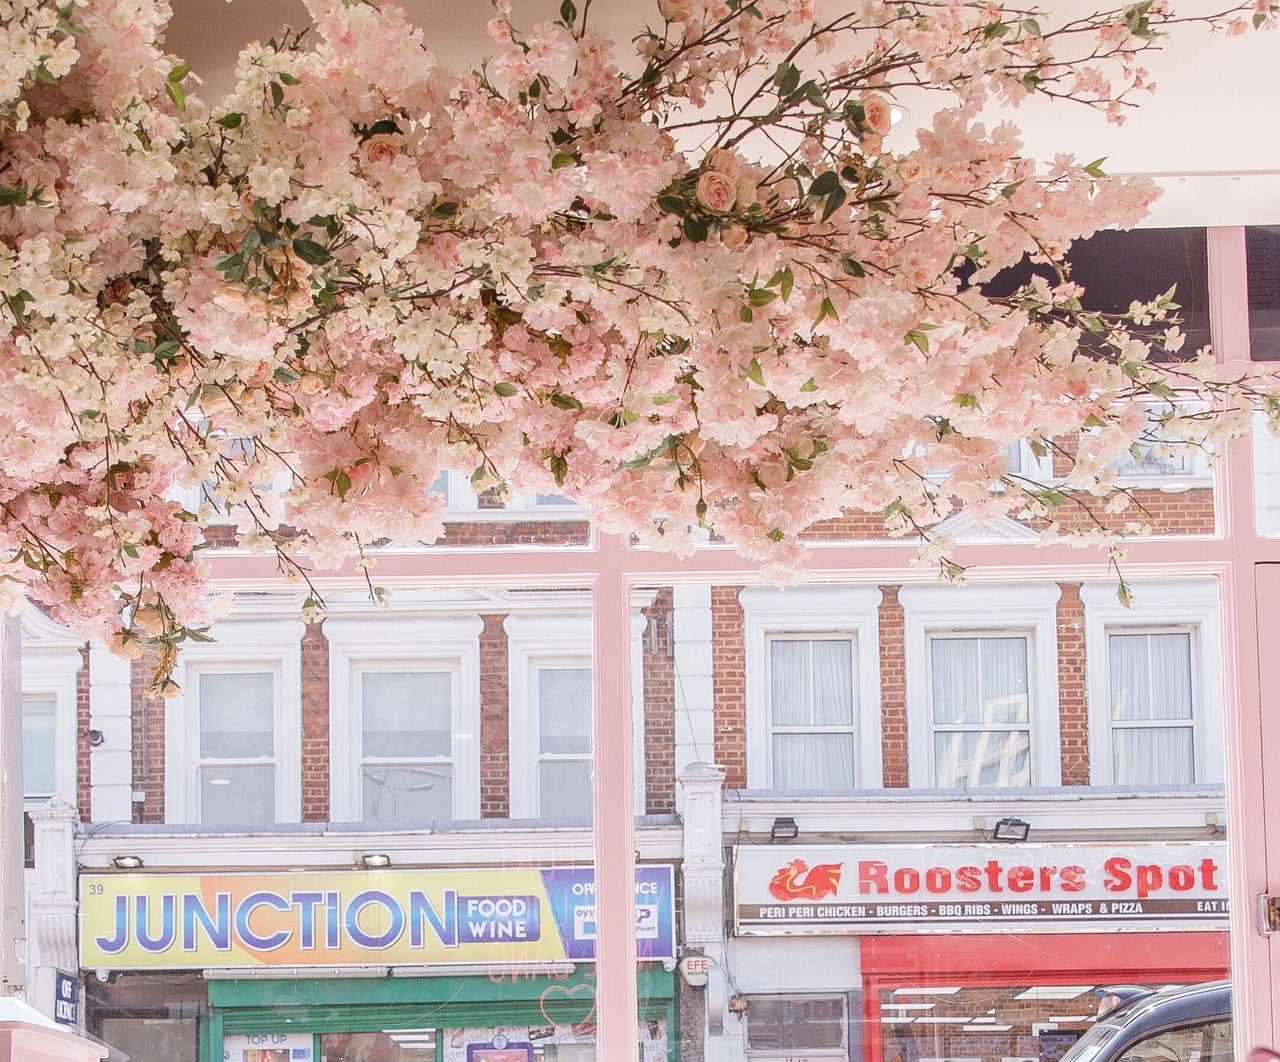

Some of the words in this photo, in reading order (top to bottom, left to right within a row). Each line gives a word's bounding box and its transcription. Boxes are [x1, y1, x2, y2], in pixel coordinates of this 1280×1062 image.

[858, 860, 1087, 895] Roosters
[1104, 857, 1218, 898] Spot
[89, 884, 104, 895] 39
[468, 899, 527, 917] FOOD
[760, 907, 785, 918] PERI
[788, 907, 814, 917] PERI
[817, 906, 866, 917] CHICKEN
[877, 905, 928, 917] BURGERS
[939, 905, 961, 917] BBQ
[965, 904, 991, 915] RIBS
[1001, 903, 1038, 914] WINGS
[1052, 903, 1092, 914] WRAPS
[1100, 903, 1108, 913] &
[1112, 902, 1143, 913] PIZZA
[1197, 901, 1217, 911] EAT
[95, 890, 459, 954] JUNCTION
[468, 920, 527, 938] WINE
[687, 960, 708, 970] EFE
[245, 1035, 267, 1045] TOP
[272, 1034, 287, 1045] UP
